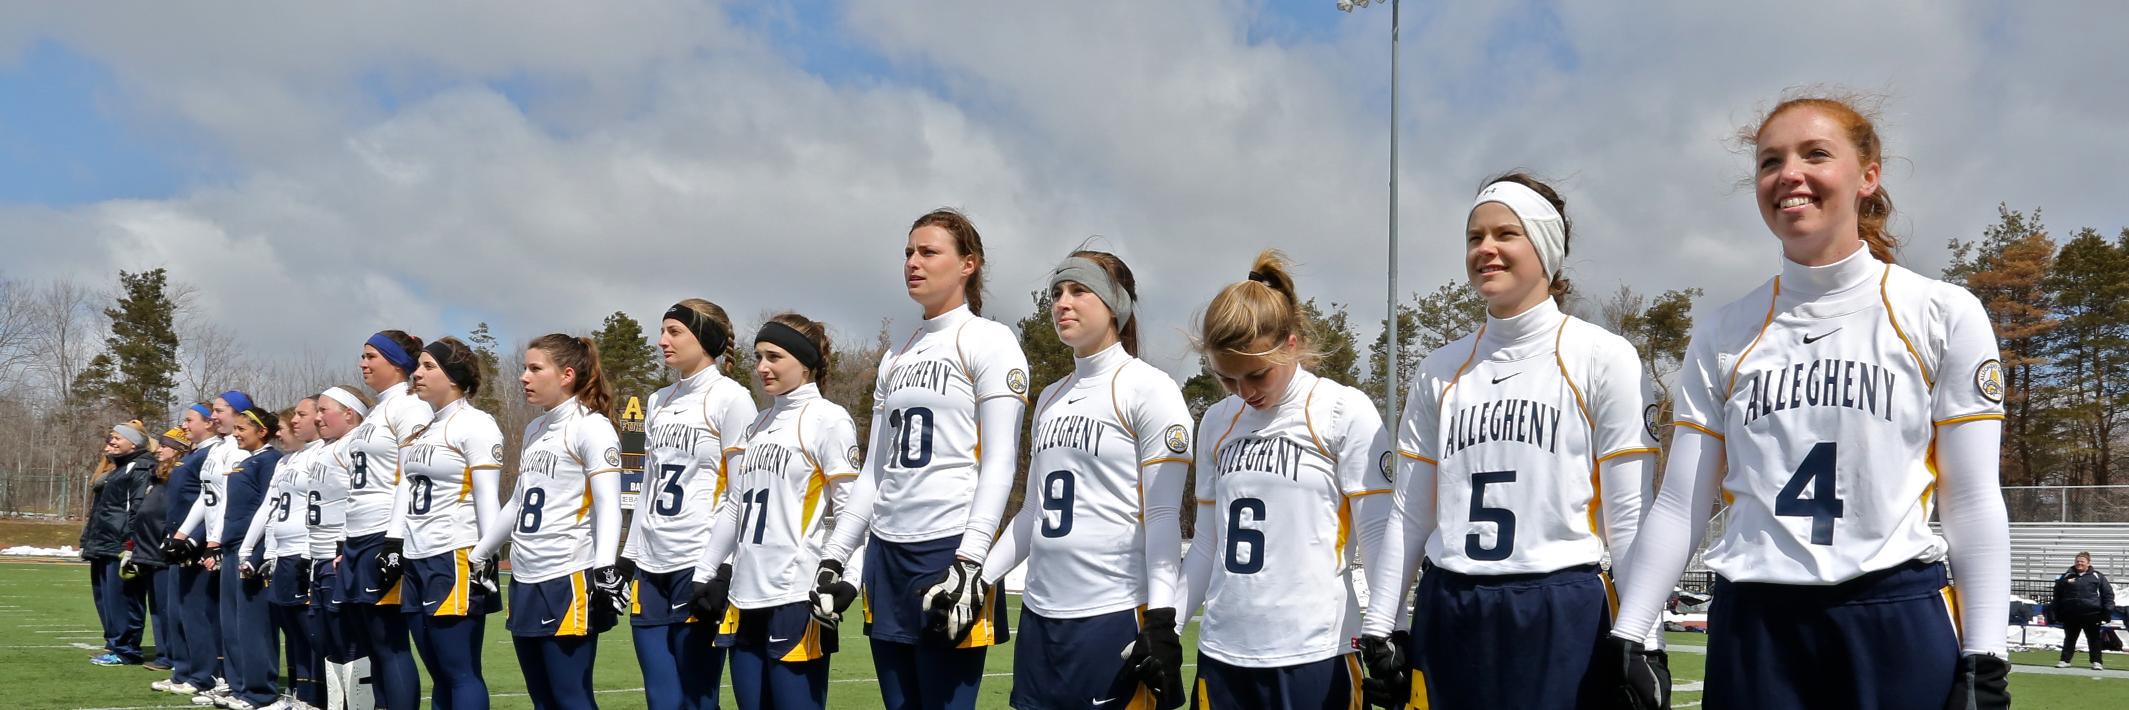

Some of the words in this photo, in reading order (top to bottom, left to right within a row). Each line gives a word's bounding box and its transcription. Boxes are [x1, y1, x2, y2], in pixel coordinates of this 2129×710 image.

[622, 396, 645, 420] A
[1744, 359, 1896, 426] ALLEGHENY
[652, 423, 701, 457] LLEGHENY
[888, 407, 934, 469] 10
[1034, 415, 1105, 457] LLEGHENY
[1444, 399, 1561, 460] ALLEGHENY
[522, 450, 559, 480] LLEGHENY
[739, 443, 792, 480] LLEGHENY
[739, 488, 769, 545] 11
[1041, 470, 1075, 538] 9
[1465, 470, 1517, 562] 5
[1775, 442, 1844, 546] 4
[1225, 498, 1266, 575] 6
